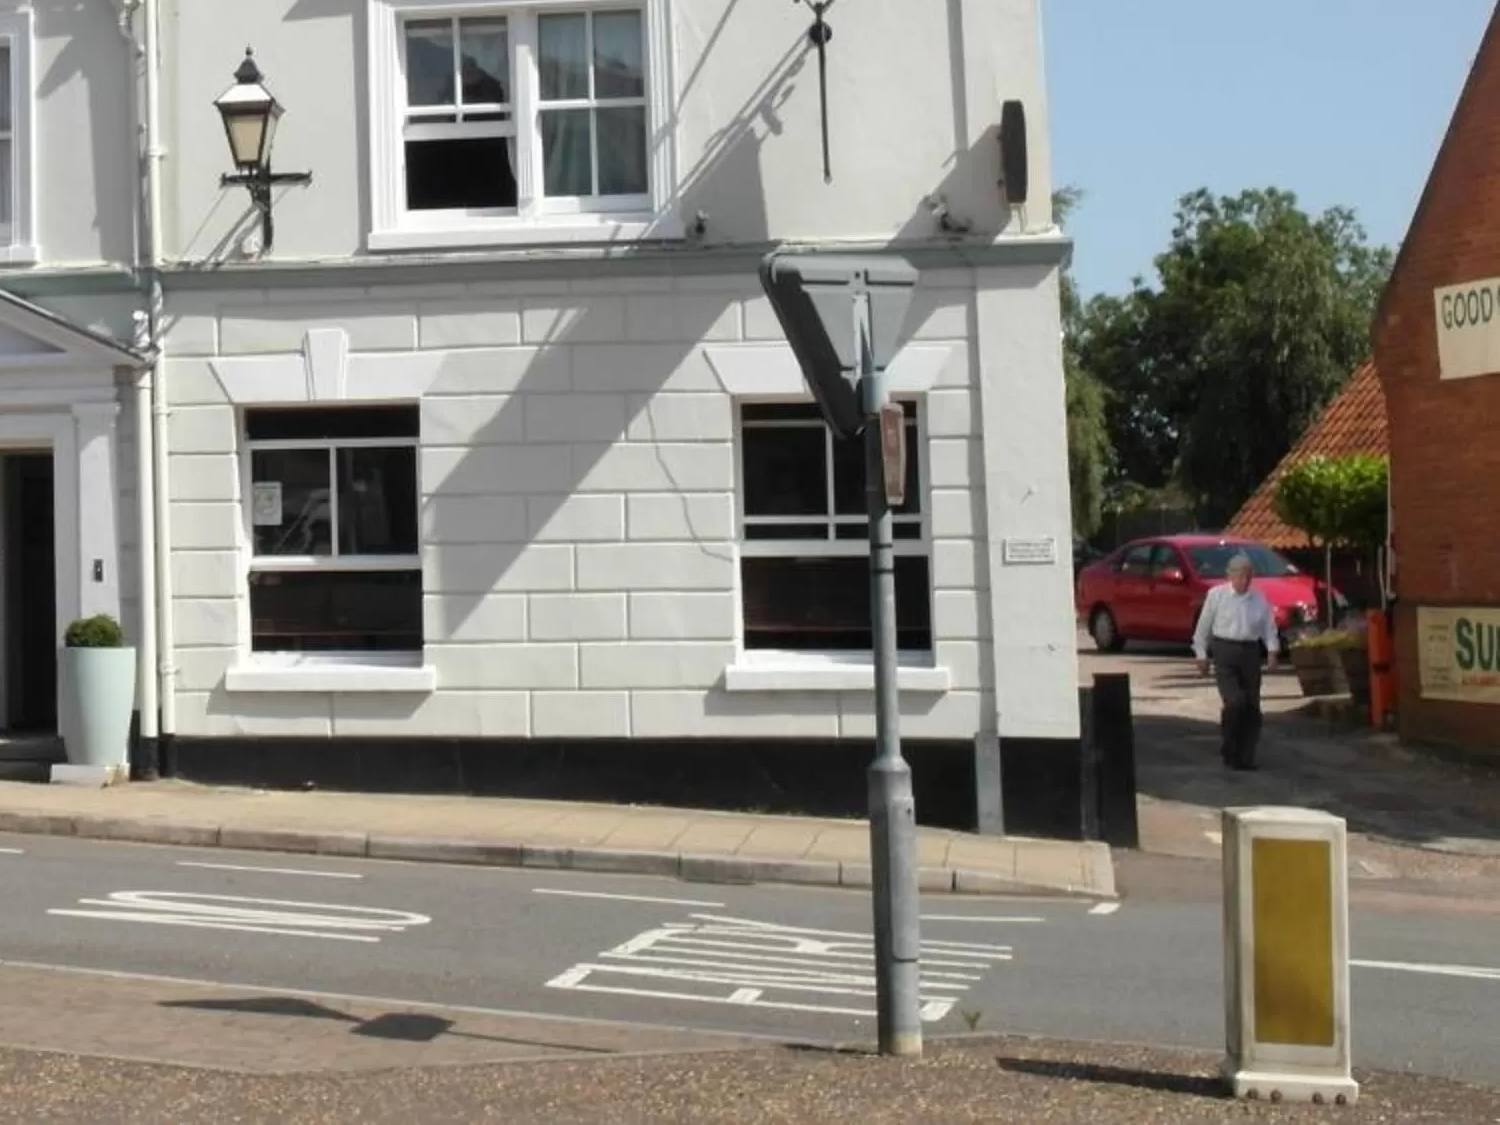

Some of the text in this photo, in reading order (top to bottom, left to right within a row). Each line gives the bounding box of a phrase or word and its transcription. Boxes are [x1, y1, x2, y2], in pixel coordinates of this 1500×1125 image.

[1455, 616, 1500, 672] SU
[46, 890, 433, 943] NO
[544, 912, 1014, 1022] ENTRY
